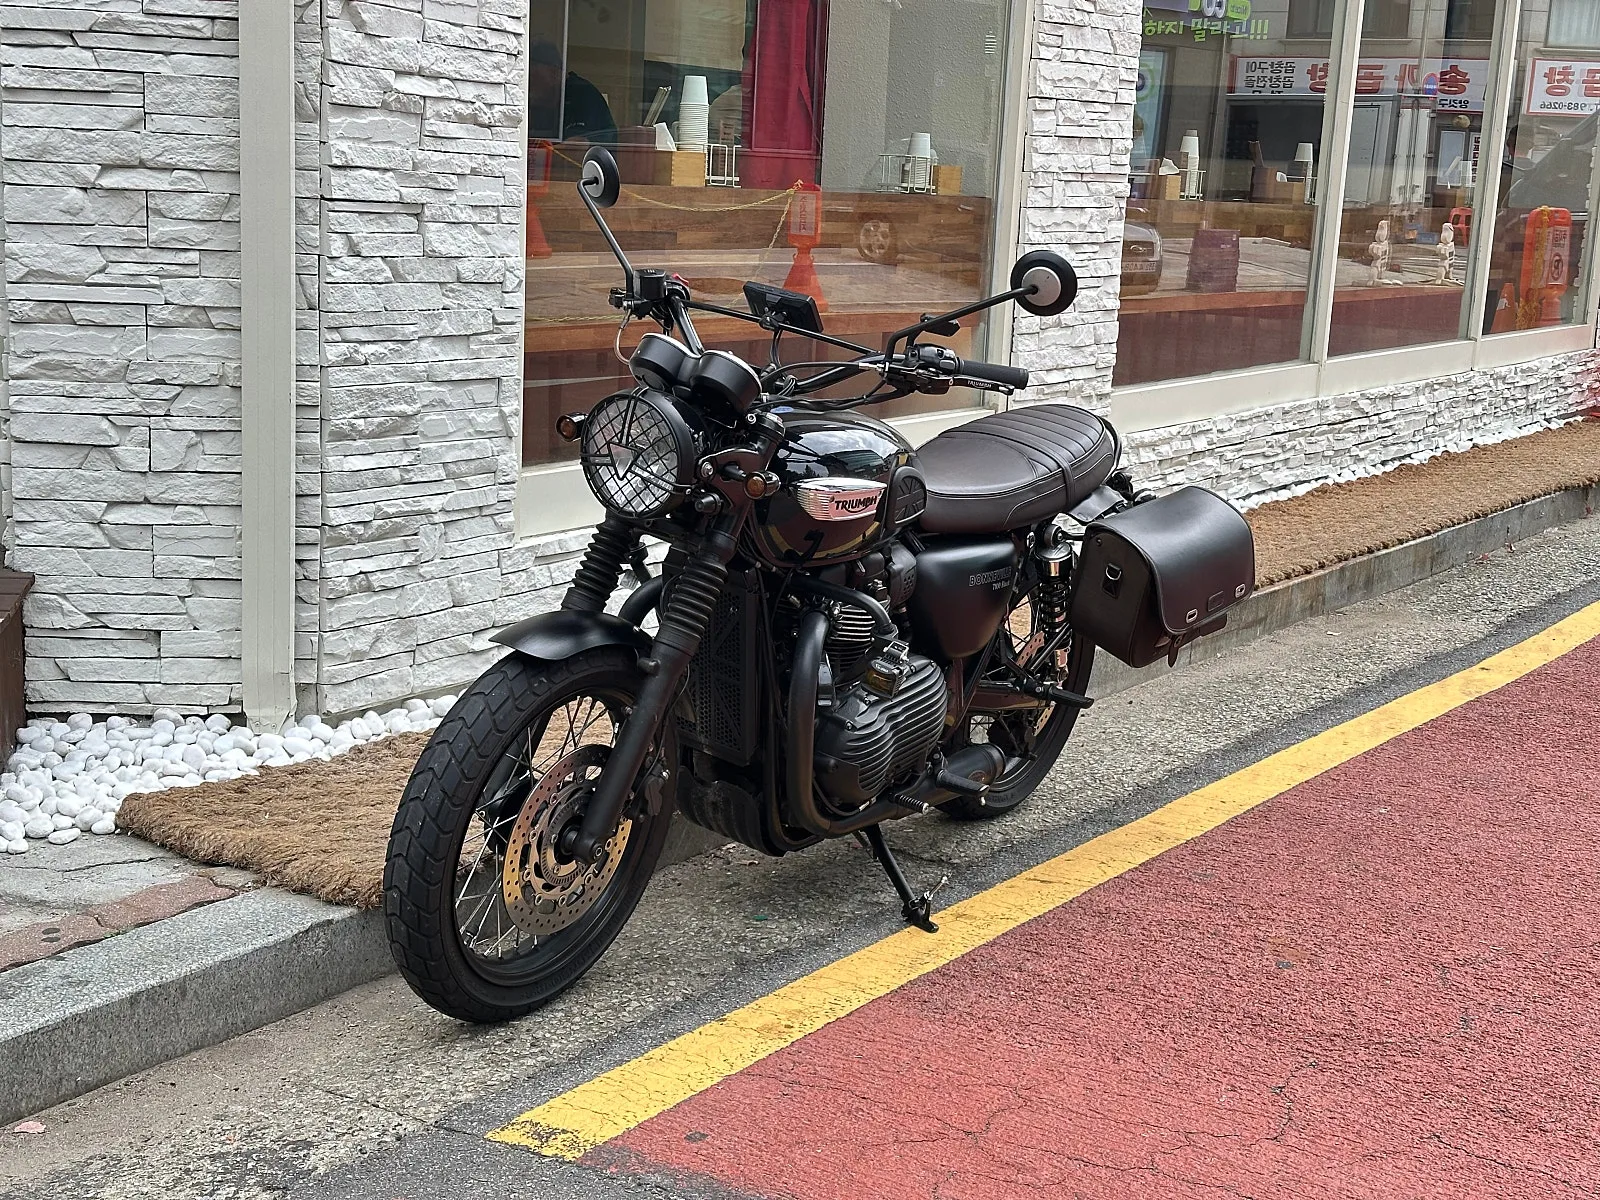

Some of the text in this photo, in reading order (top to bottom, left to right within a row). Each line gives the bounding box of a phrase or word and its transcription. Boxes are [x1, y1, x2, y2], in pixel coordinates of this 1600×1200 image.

[1144, 18, 1269, 42] 하지 말라고!!!
[834, 495, 878, 513] TRIUMPH
